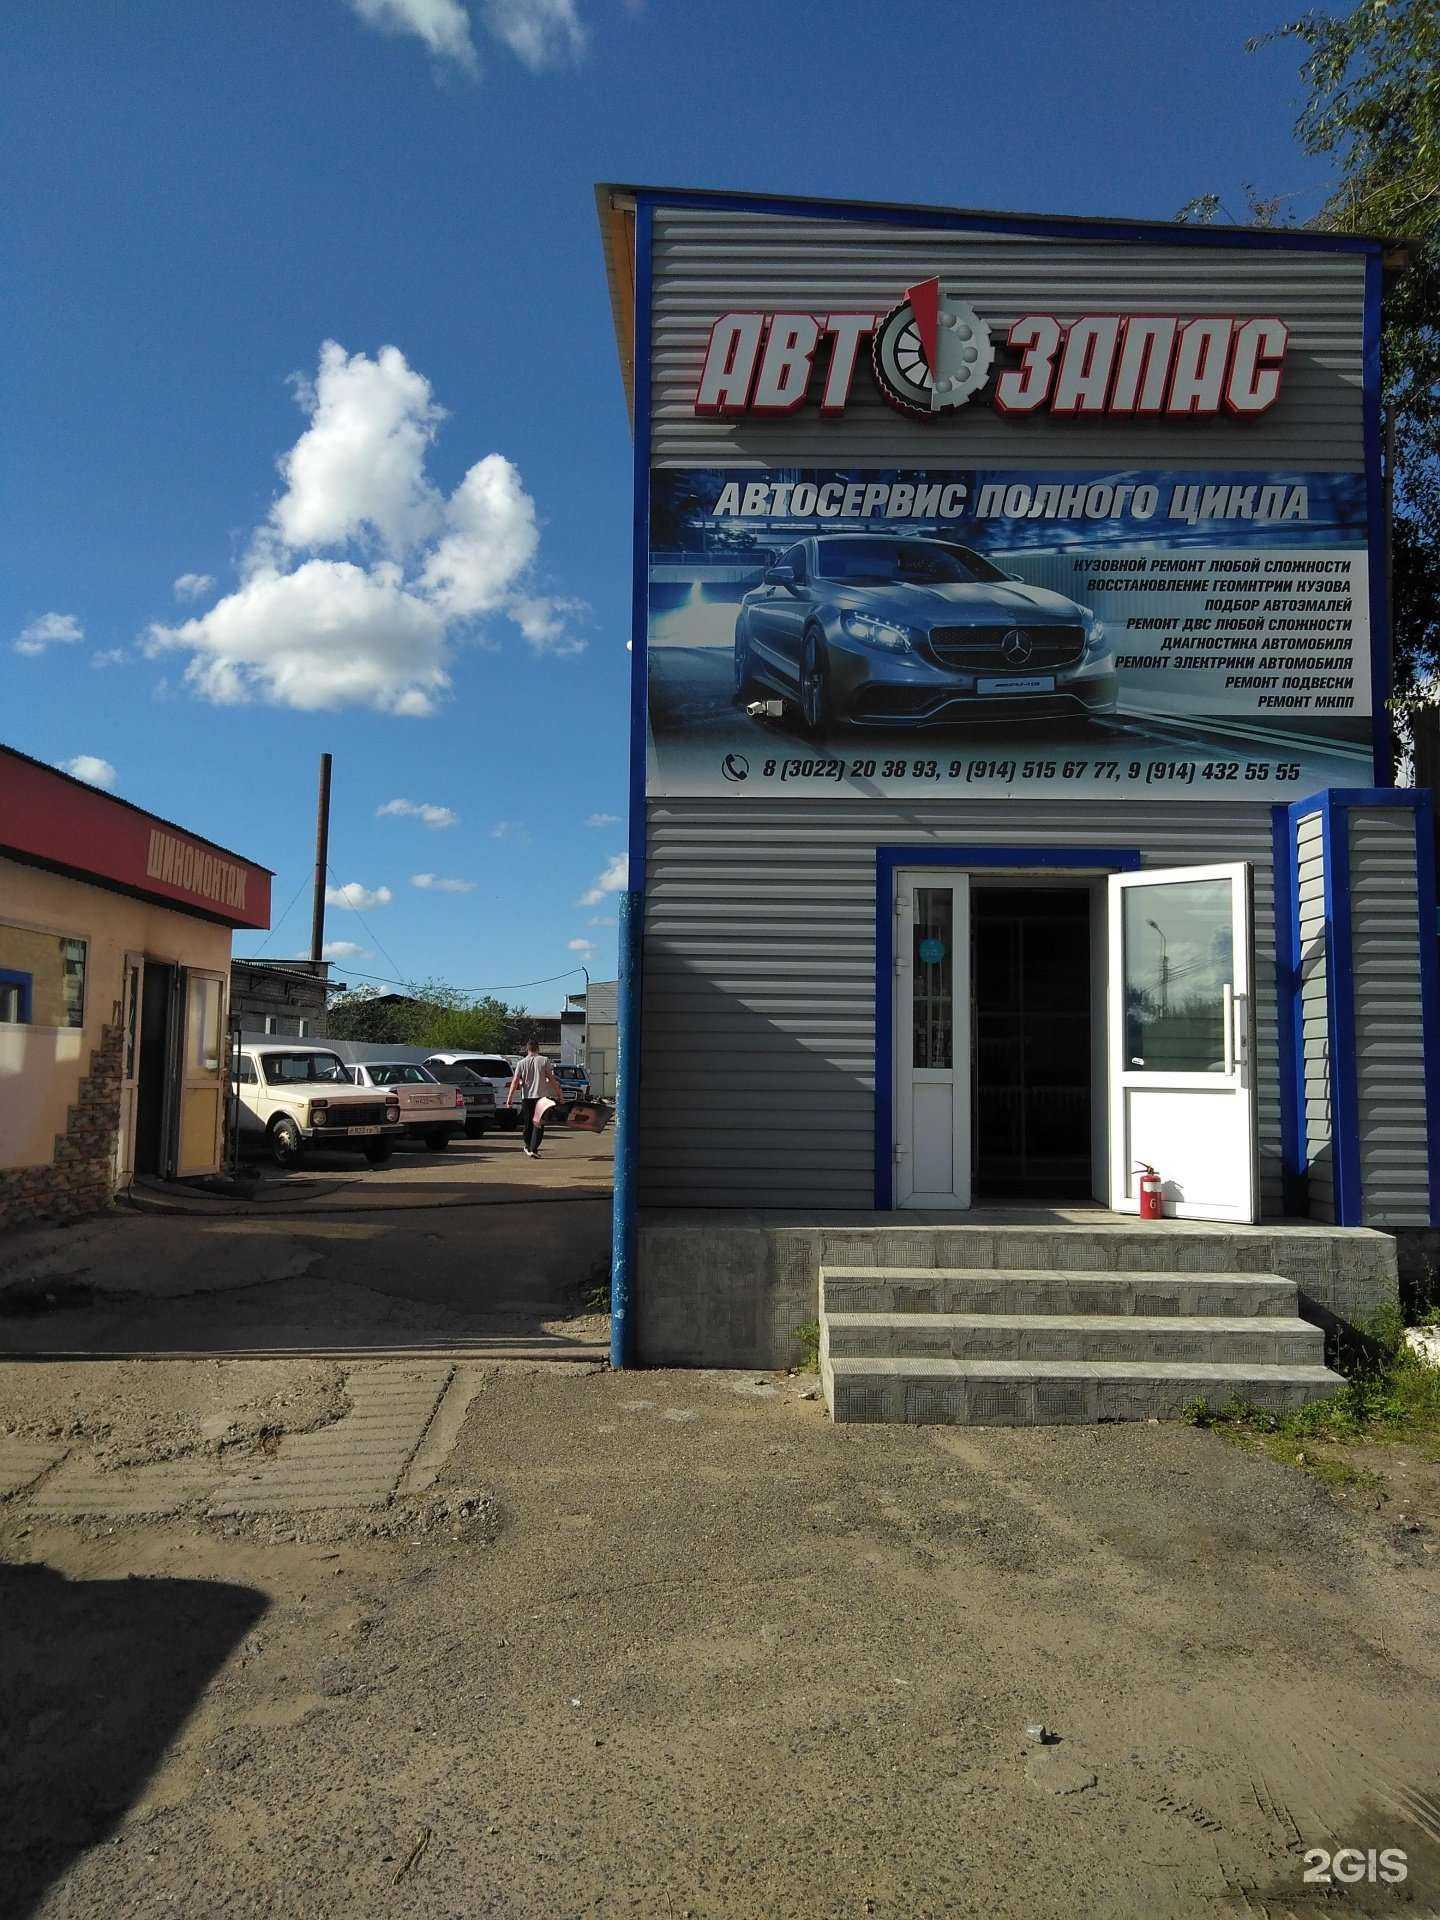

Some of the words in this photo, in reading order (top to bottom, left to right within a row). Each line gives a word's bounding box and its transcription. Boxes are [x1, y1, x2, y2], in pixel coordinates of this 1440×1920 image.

[712, 482, 969, 519] АВТОСЕРВИС
[976, 482, 1155, 519] ПОЛНОГО
[1168, 484, 1310, 525] ЦИКЛА
[1074, 557, 1147, 572] КУЗОВНОЙ
[1150, 560, 1206, 572] РЕМОНТ
[1208, 557, 1260, 573] ЛЮБОЙ
[1264, 560, 1351, 573] СЛОЖНОСТИ
[1087, 579, 1209, 592] ВОССТАНОВЛЕНИЕ
[1296, 580, 1351, 593] КУЗОВА
[1204, 599, 1259, 613] ПОДБОР
[1263, 597, 1352, 612] АВТОЭМАЛЕЙ
[1126, 618, 1180, 630] РЕМОНТ
[1182, 618, 1212, 632] ДВС
[1214, 616, 1265, 631] ЛЮБОЙ
[1268, 619, 1353, 631] СЛОЖНОСТИ
[1160, 638, 1258, 650] ДИАГНОСТИКА
[1261, 638, 1353, 650] АВТОМОБИЛЯ
[1115, 656, 1169, 669] РЕМОНТ
[1173, 656, 1255, 669] ЭЛЕКТРИКИ
[1258, 657, 1353, 670] АВТОМОБИЛЯ
[1225, 676, 1279, 689] РЕМОНТ
[1282, 677, 1354, 691] ПОДВЕСКИ
[1258, 696, 1312, 708] РЕМОНТ
[1315, 696, 1355, 708] МКПП
[763, 760, 777, 777] 8
[780, 759, 845, 782] (3022)
[850, 760, 876, 777] 20
[882, 760, 906, 777] 38
[912, 760, 941, 781] 93,
[949, 761, 962, 778] 9
[966, 760, 1016, 783] (914)
[1022, 761, 1056, 778] 515
[1062, 761, 1087, 778] 67
[1093, 761, 1121, 782] 77,
[1128, 762, 1141, 779] 9
[1146, 761, 1196, 784] (914)
[1202, 762, 1238, 780] 432
[1245, 763, 1270, 780] 55
[1275, 763, 1301, 780] 55
[147, 829, 247, 911] ШИНОМОНТАЖ
